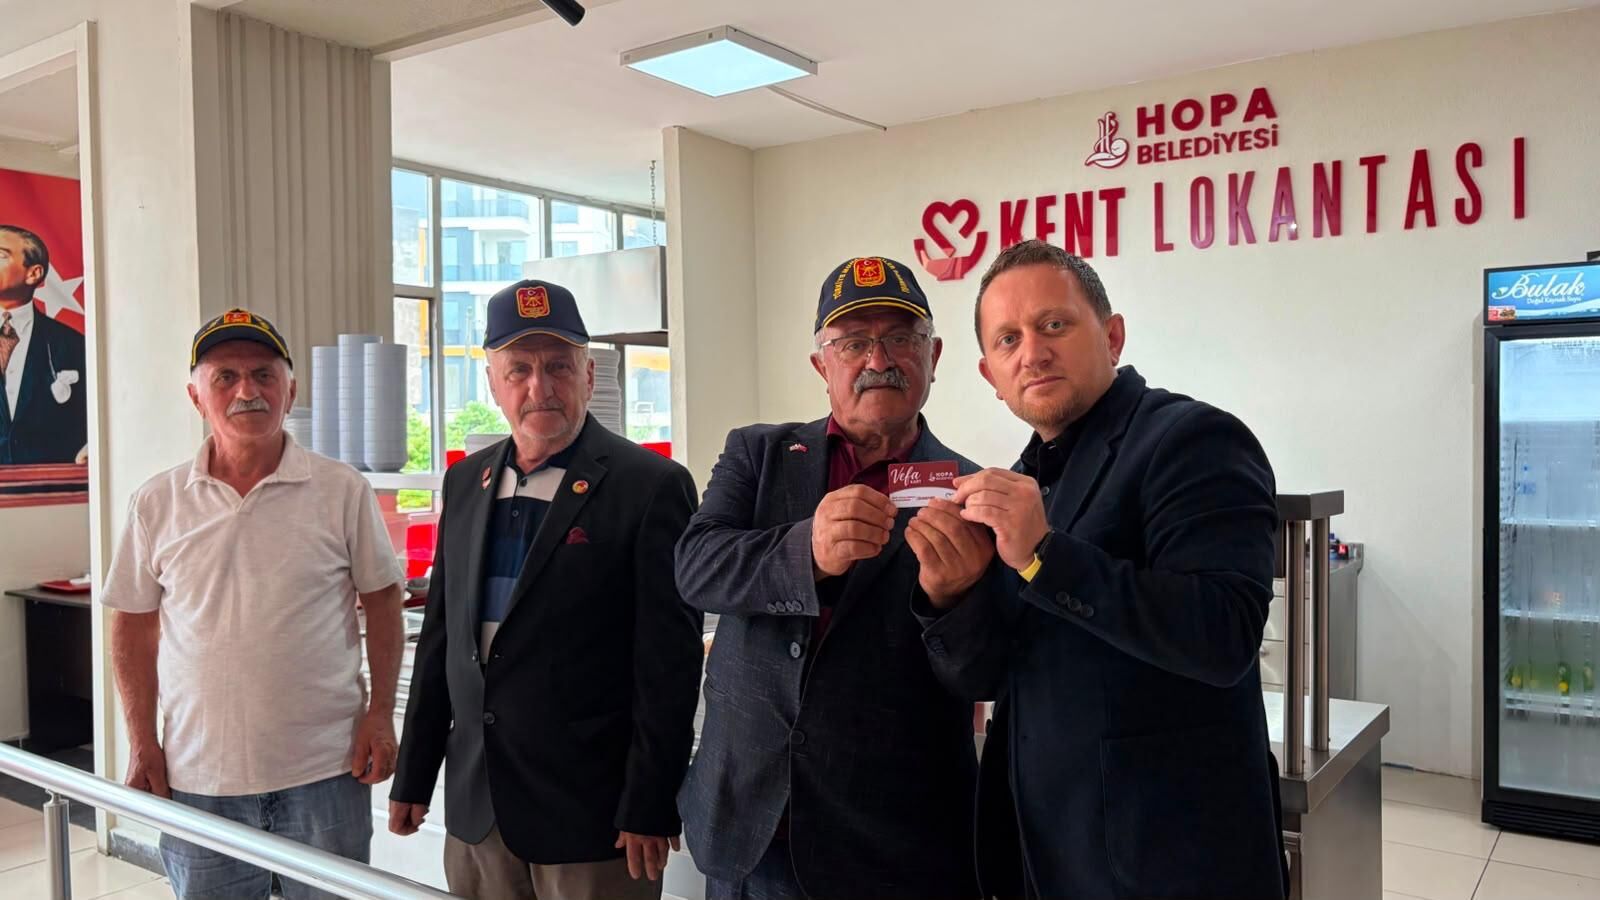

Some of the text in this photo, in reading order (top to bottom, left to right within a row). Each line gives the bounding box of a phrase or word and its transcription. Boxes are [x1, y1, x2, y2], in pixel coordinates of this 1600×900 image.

[1137, 87, 1278, 138] HOPA
[1000, 136, 1526, 259] KENT LOKANTASI
[1492, 272, 1584, 299] Bulak
[890, 466, 921, 486] Vefa
